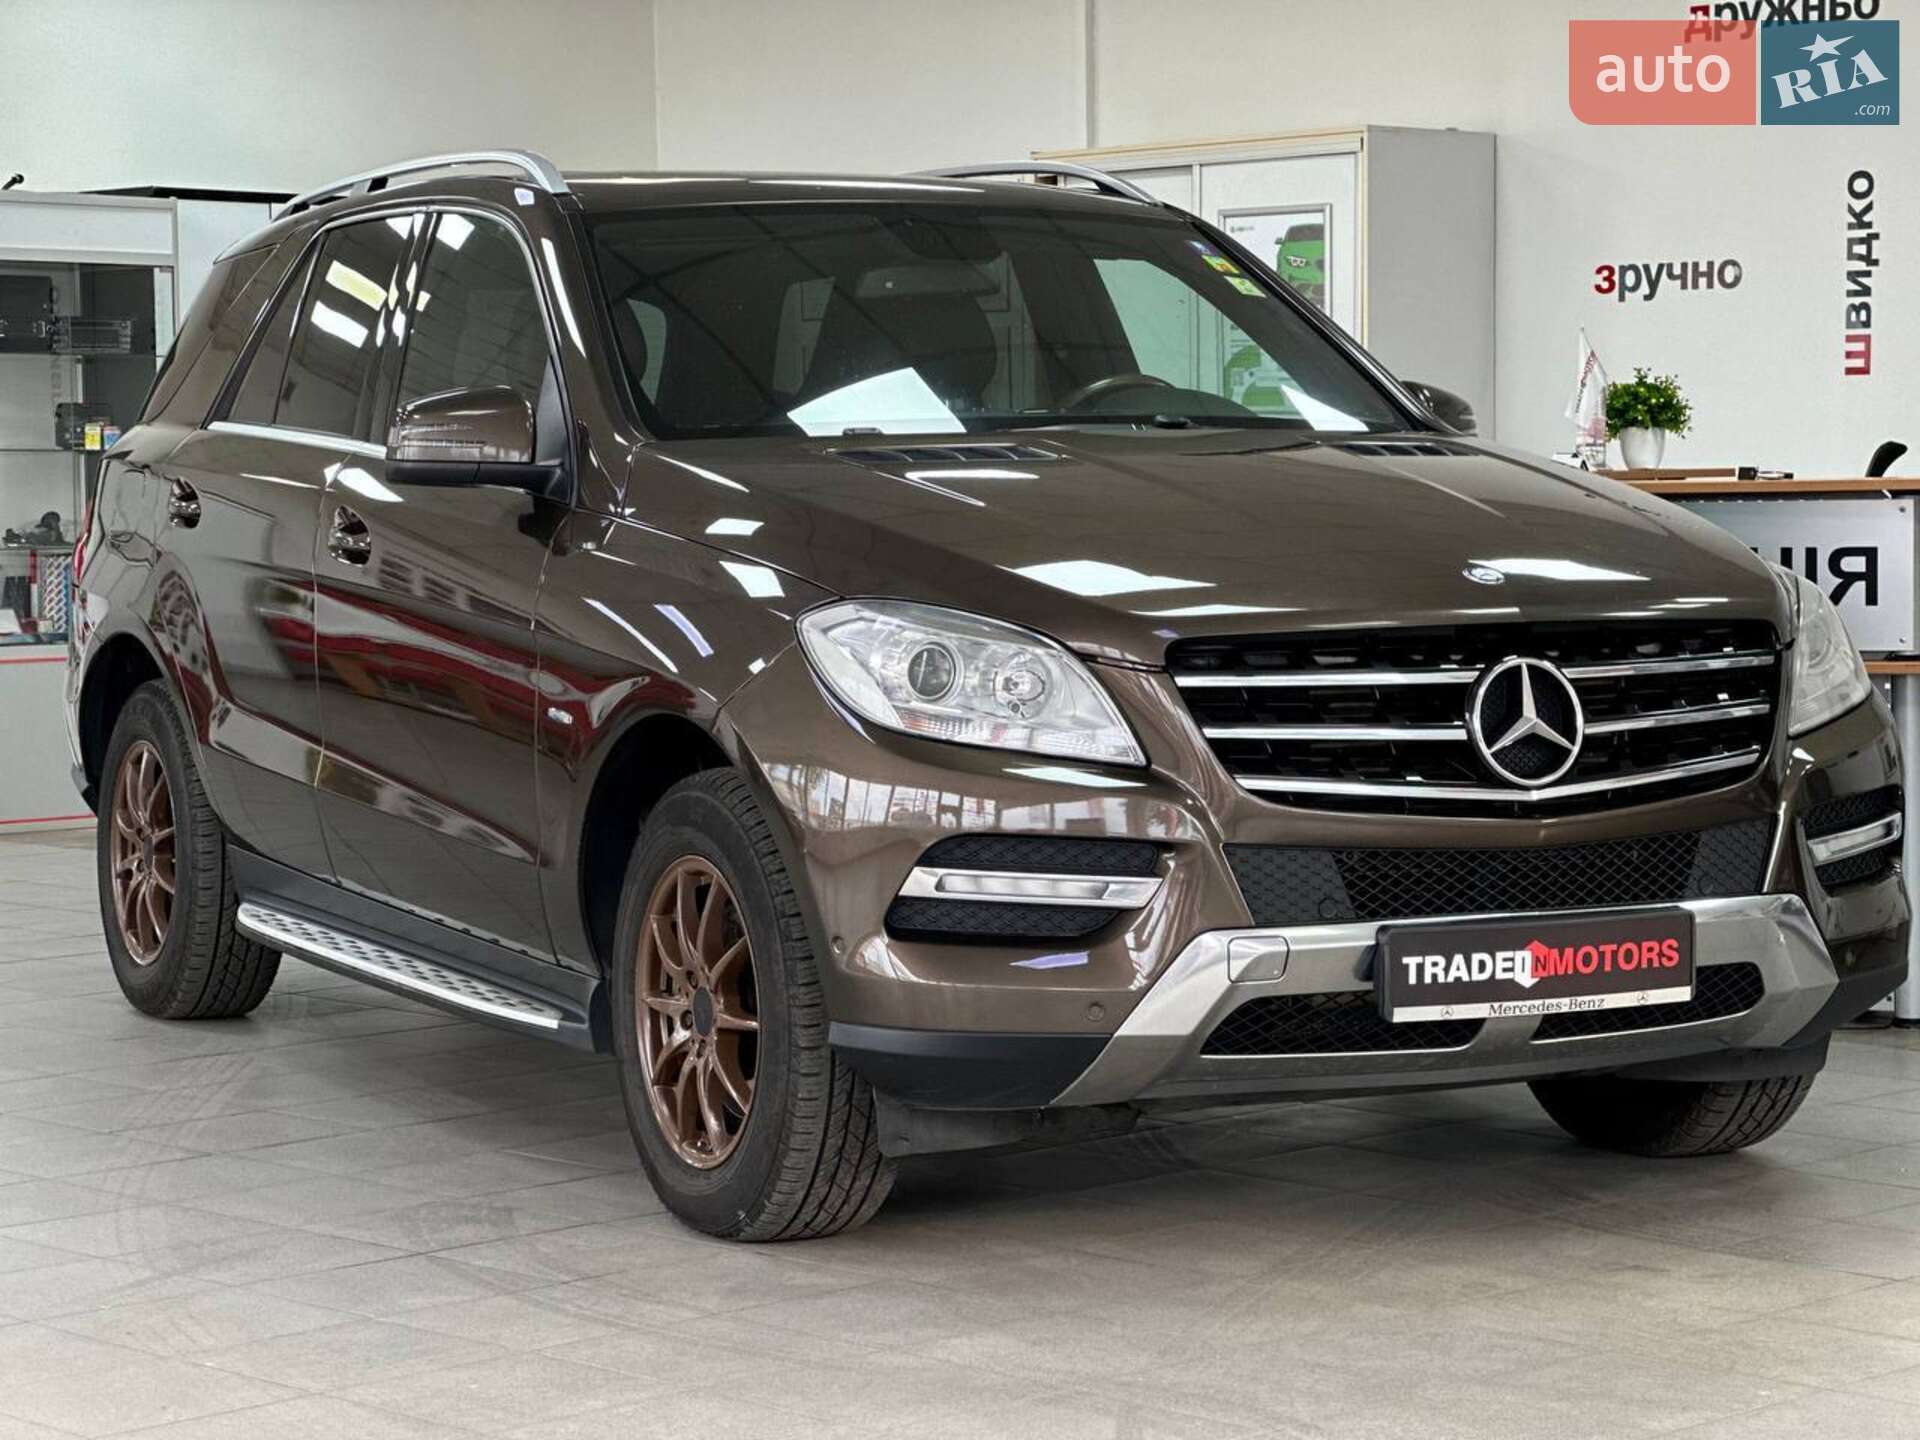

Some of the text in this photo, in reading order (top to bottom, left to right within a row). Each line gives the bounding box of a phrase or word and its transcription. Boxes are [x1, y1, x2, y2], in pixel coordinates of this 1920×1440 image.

[1594, 258, 1743, 302] зручно
[1844, 169, 1880, 376] швидко
[1488, 996, 1606, 1018] Mercedes-Benz
